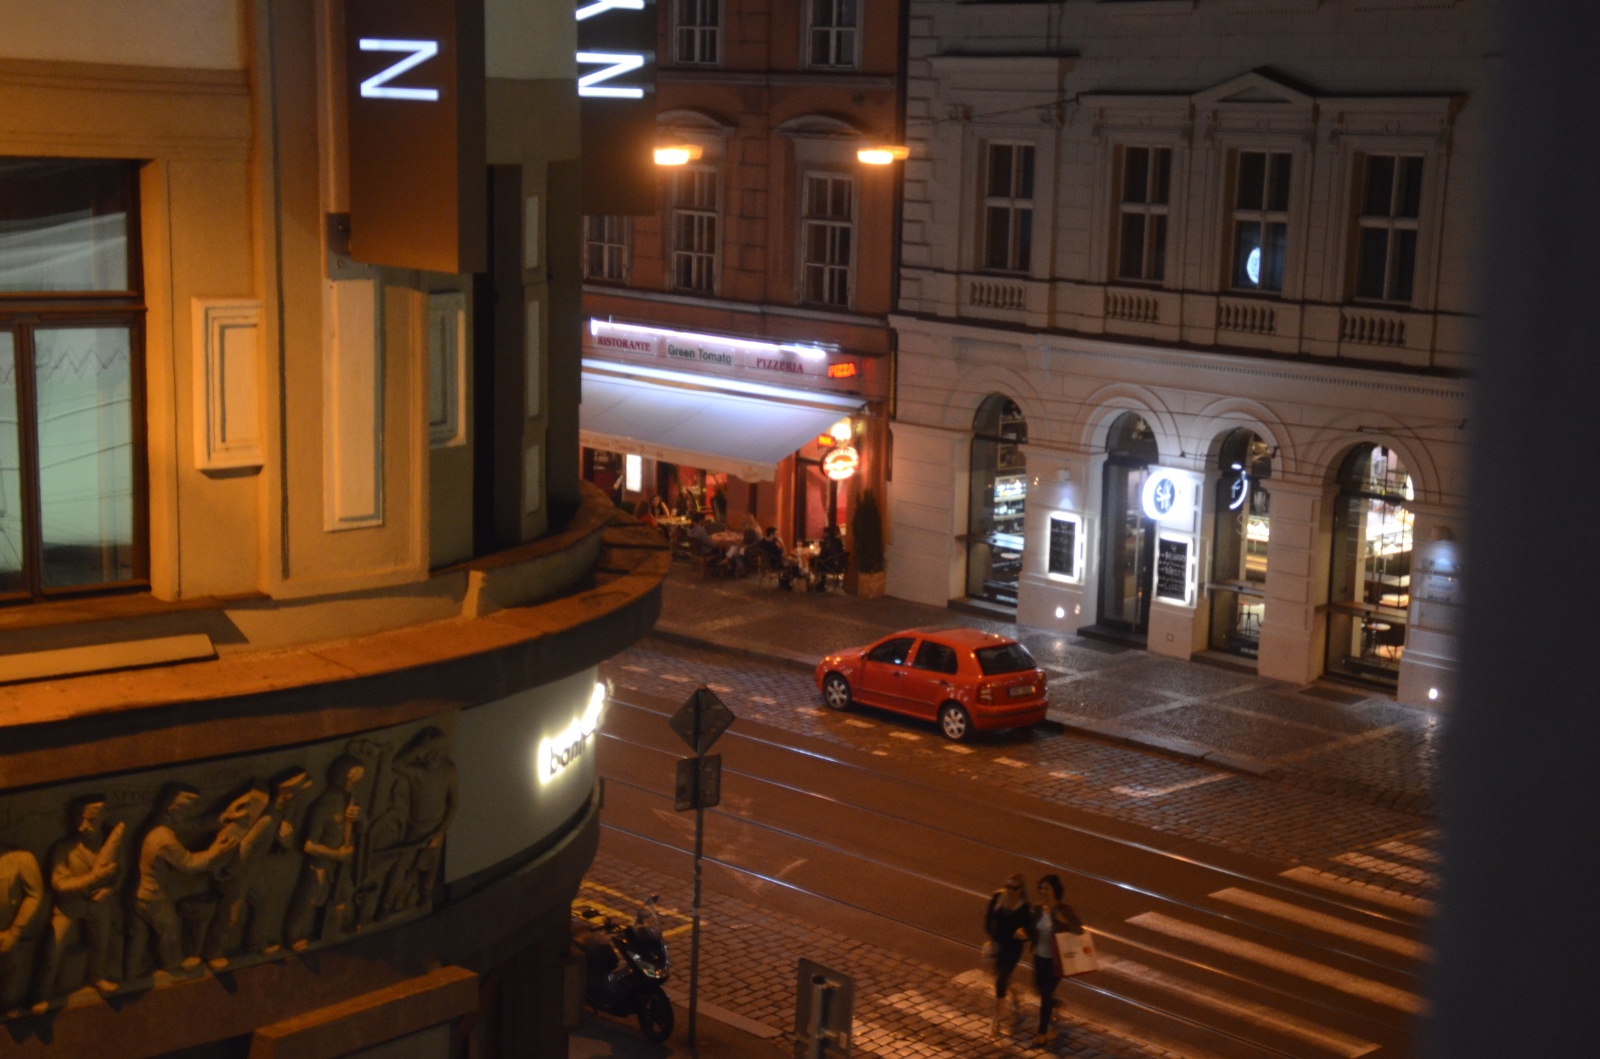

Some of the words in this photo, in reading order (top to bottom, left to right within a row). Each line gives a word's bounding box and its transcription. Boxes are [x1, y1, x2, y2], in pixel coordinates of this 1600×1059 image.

[597, 335, 651, 352] RISTORANTE
[667, 344, 695, 358] Green
[698, 348, 732, 363] Tomato
[756, 357, 804, 374] PIZZERIA
[828, 362, 857, 378] PIZZA
